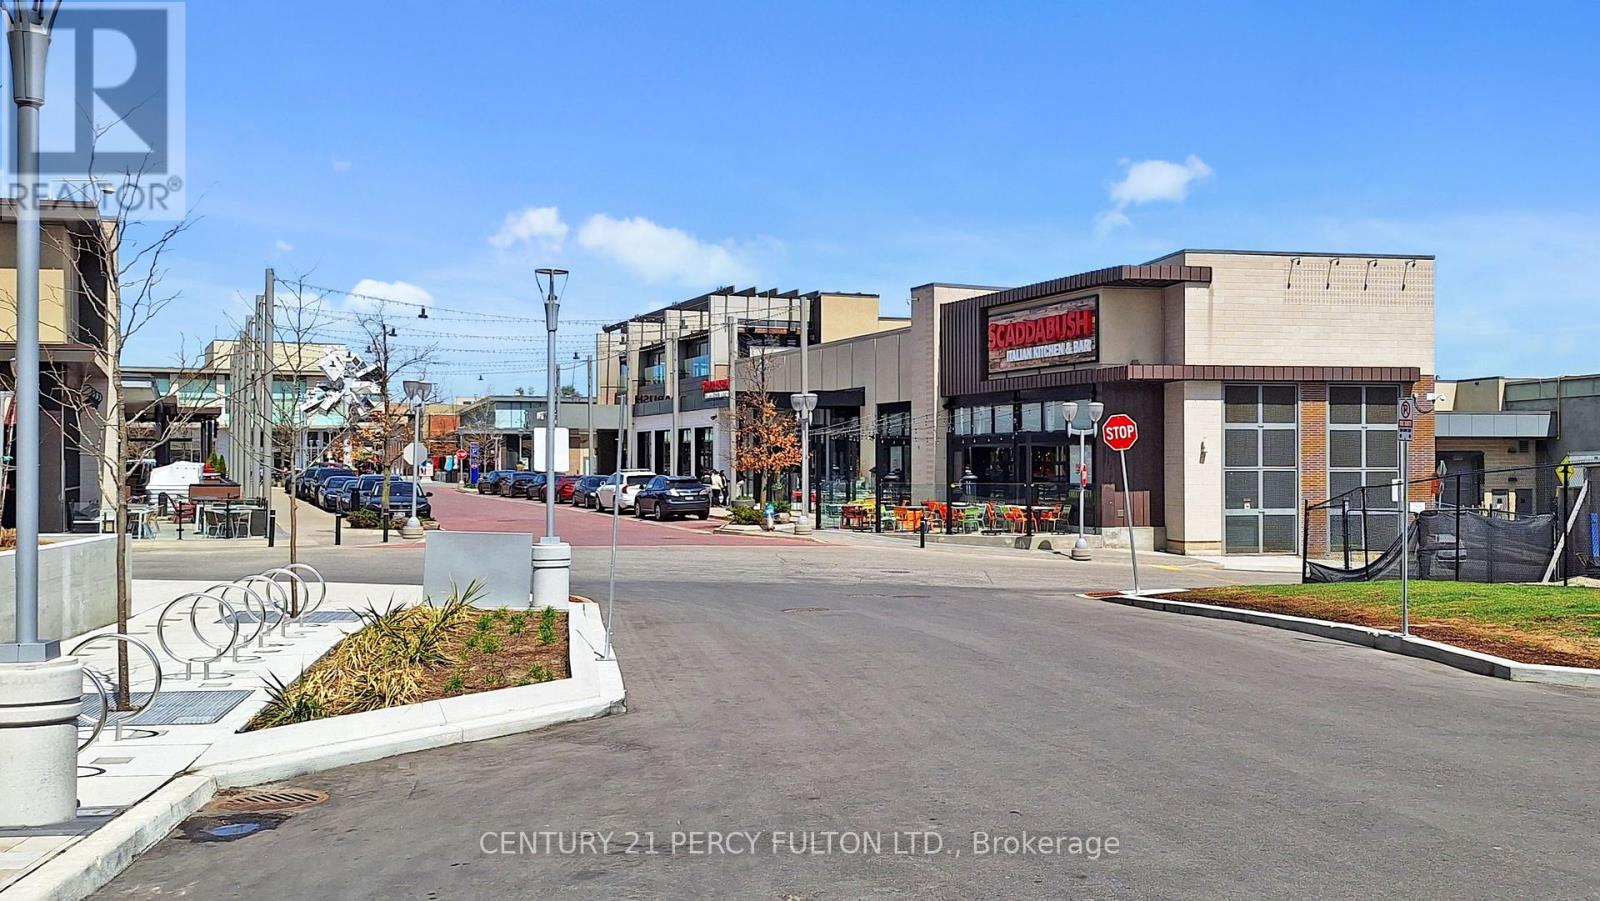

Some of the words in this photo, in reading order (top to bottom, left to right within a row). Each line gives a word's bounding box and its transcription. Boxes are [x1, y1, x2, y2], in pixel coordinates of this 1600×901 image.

[988, 309, 1091, 350] SCADDABUSH
[1007, 346, 1033, 362] ITALIAN
[1033, 342, 1065, 359] KITCHEN
[1065, 341, 1073, 355] &
[1073, 339, 1092, 354] BAR
[1106, 425, 1134, 440] STOP
